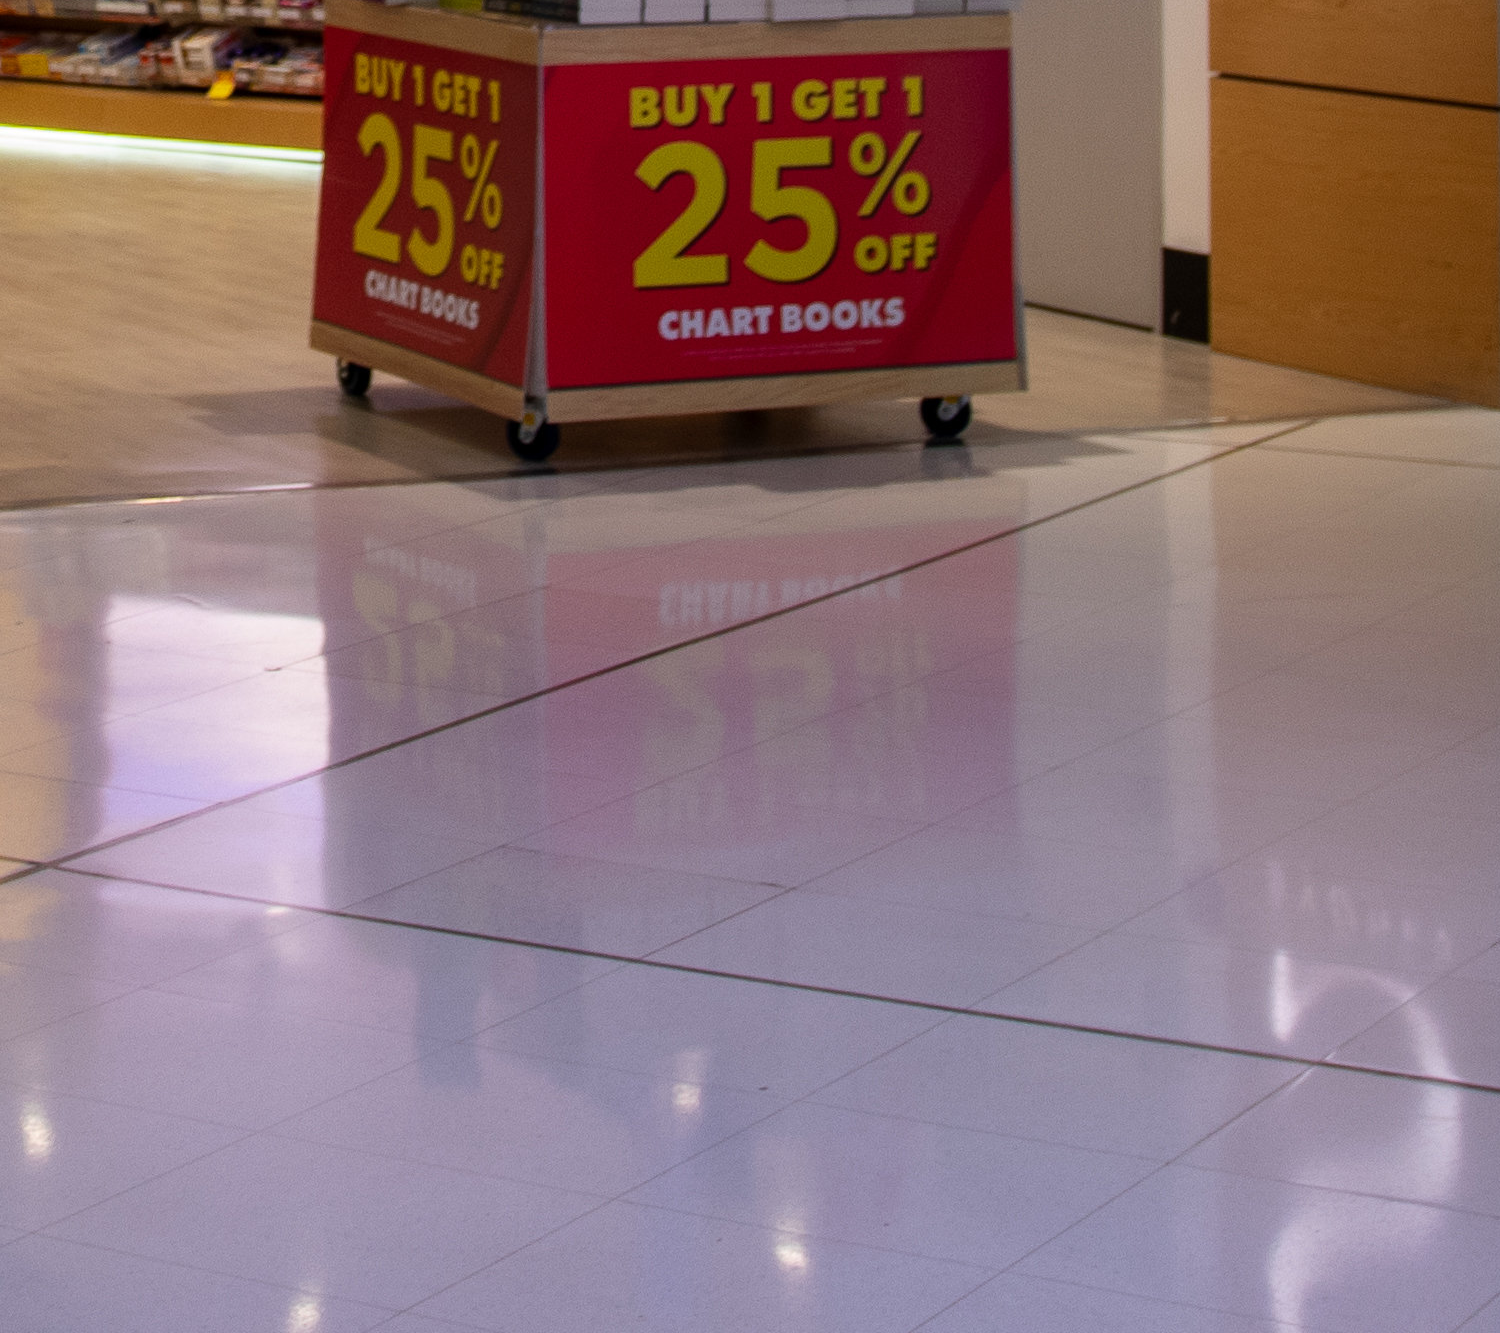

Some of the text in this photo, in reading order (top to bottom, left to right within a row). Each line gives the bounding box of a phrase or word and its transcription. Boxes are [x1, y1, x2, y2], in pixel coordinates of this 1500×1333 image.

[353, 52, 502, 123] BUY 1 GET 1
[629, 75, 925, 129] BUY 1 GET 1
[352, 111, 503, 277] 25%
[632, 129, 933, 290] 25%
[460, 244, 505, 291] OFF
[852, 232, 937, 274] OFF
[364, 267, 419, 319] CHART
[420, 282, 480, 331] BOOKS
[658, 296, 906, 341] CHART BOOKS
